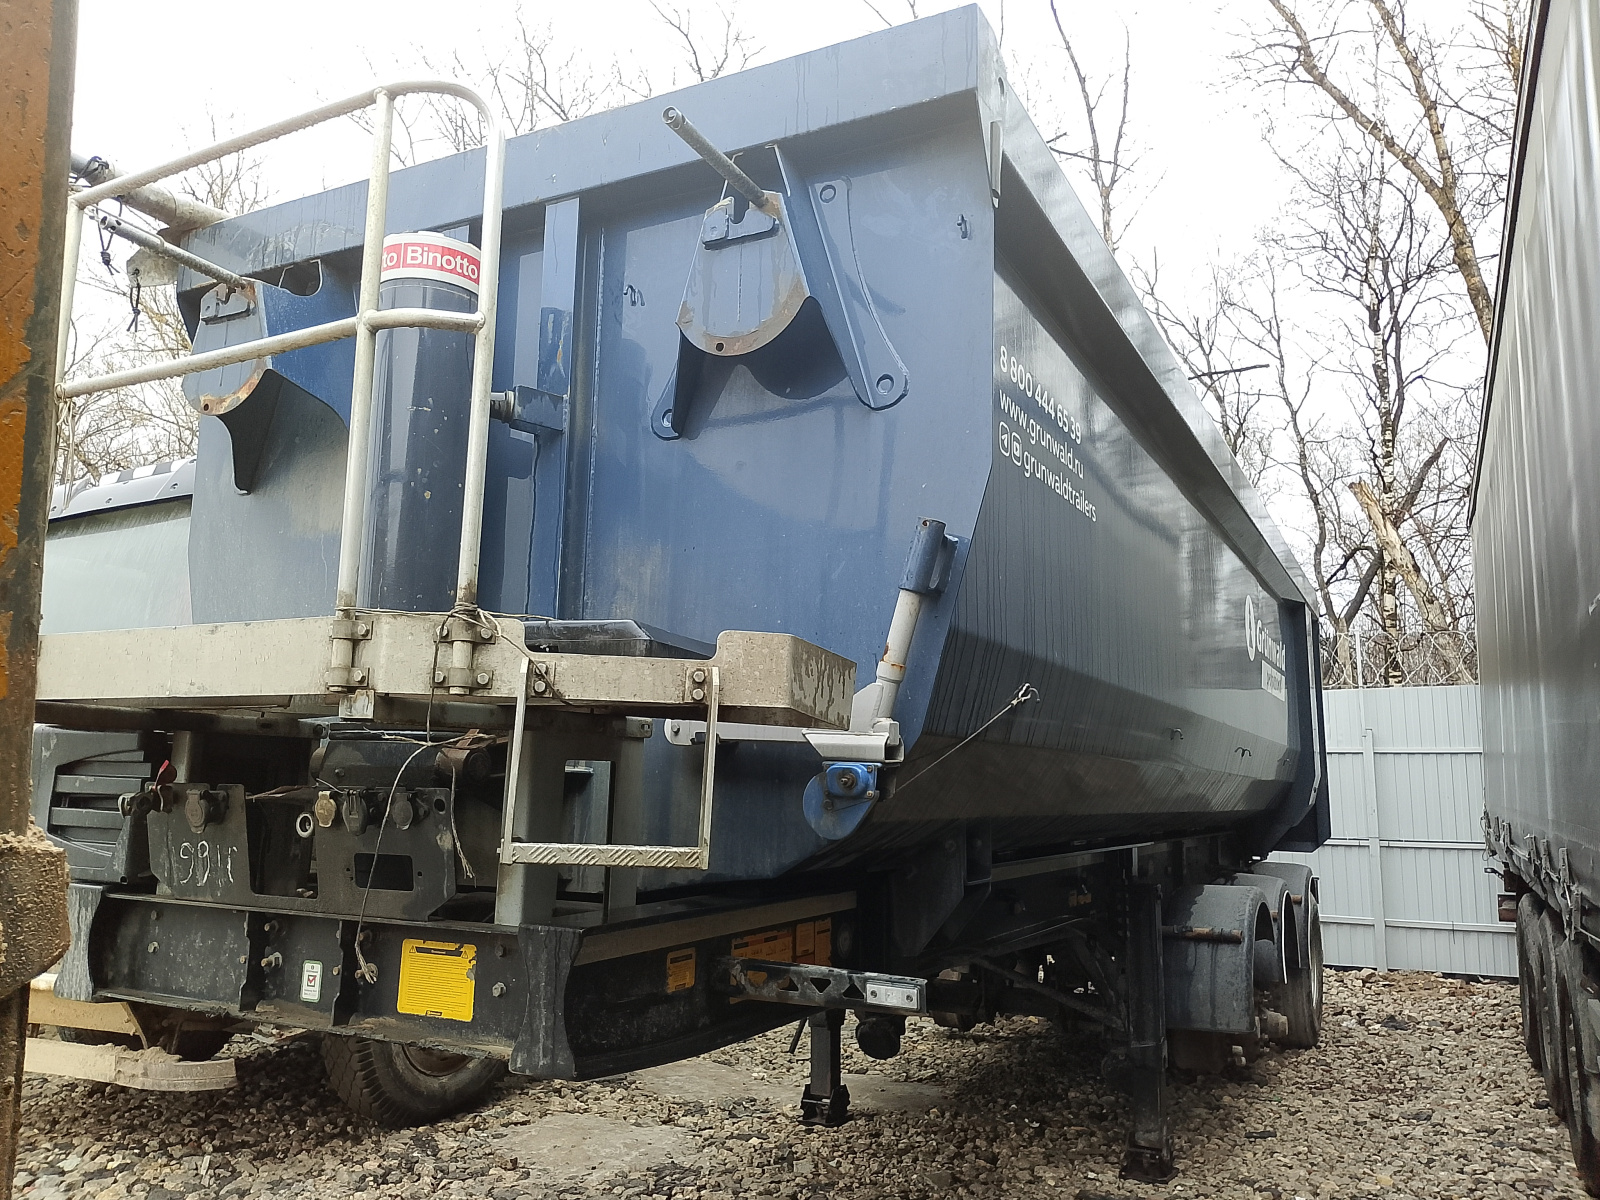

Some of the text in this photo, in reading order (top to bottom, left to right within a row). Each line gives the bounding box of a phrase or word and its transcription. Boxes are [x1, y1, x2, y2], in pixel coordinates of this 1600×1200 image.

[406, 246, 478, 279] Binotto
[999, 389, 1084, 480] www.grunwald.ru
[1000, 345, 1082, 445] 8 800 444 65 39
[1024, 450, 1097, 523] grunwaldtrailers
